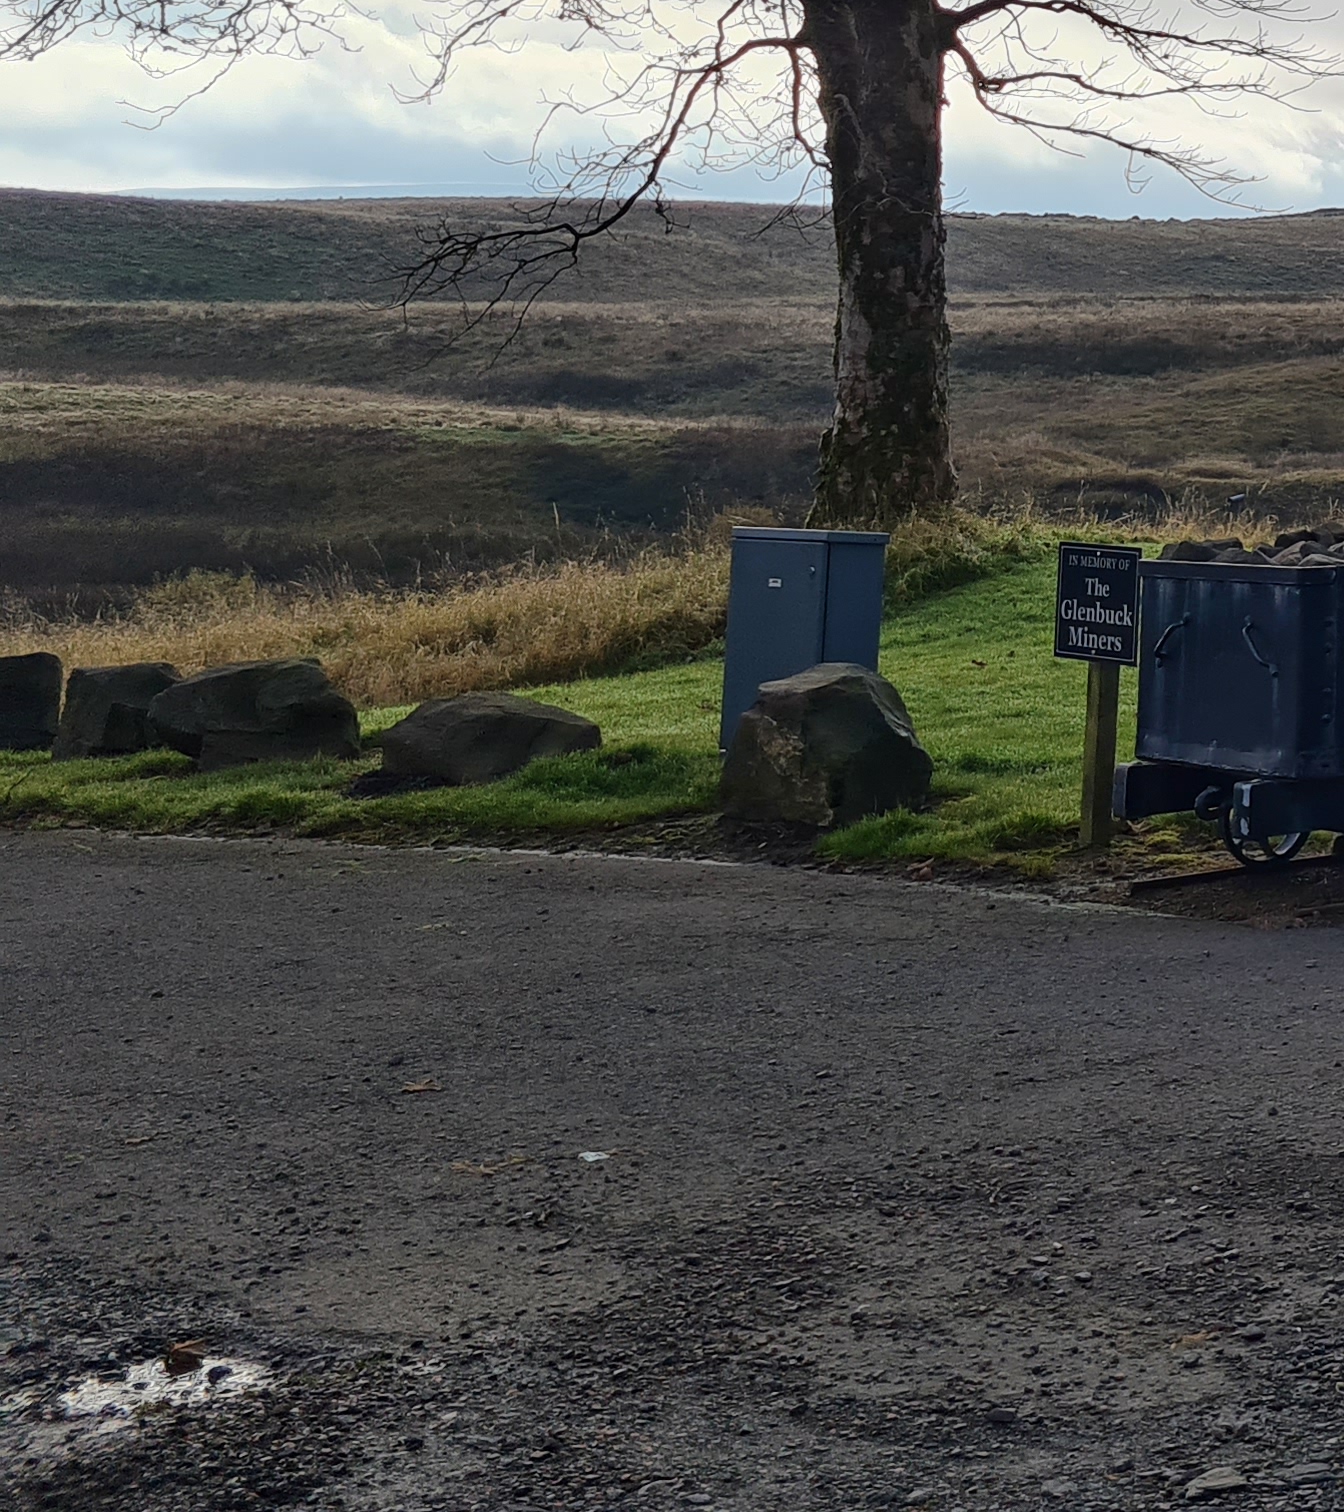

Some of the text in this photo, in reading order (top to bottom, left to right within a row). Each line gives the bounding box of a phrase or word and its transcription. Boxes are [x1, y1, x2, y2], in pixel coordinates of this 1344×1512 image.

[1069, 555, 1131, 571] IN MEMORY OF
[1085, 578, 1110, 597] The
[1061, 599, 1133, 626] Glenbuck
[1068, 626, 1122, 651] Miners
